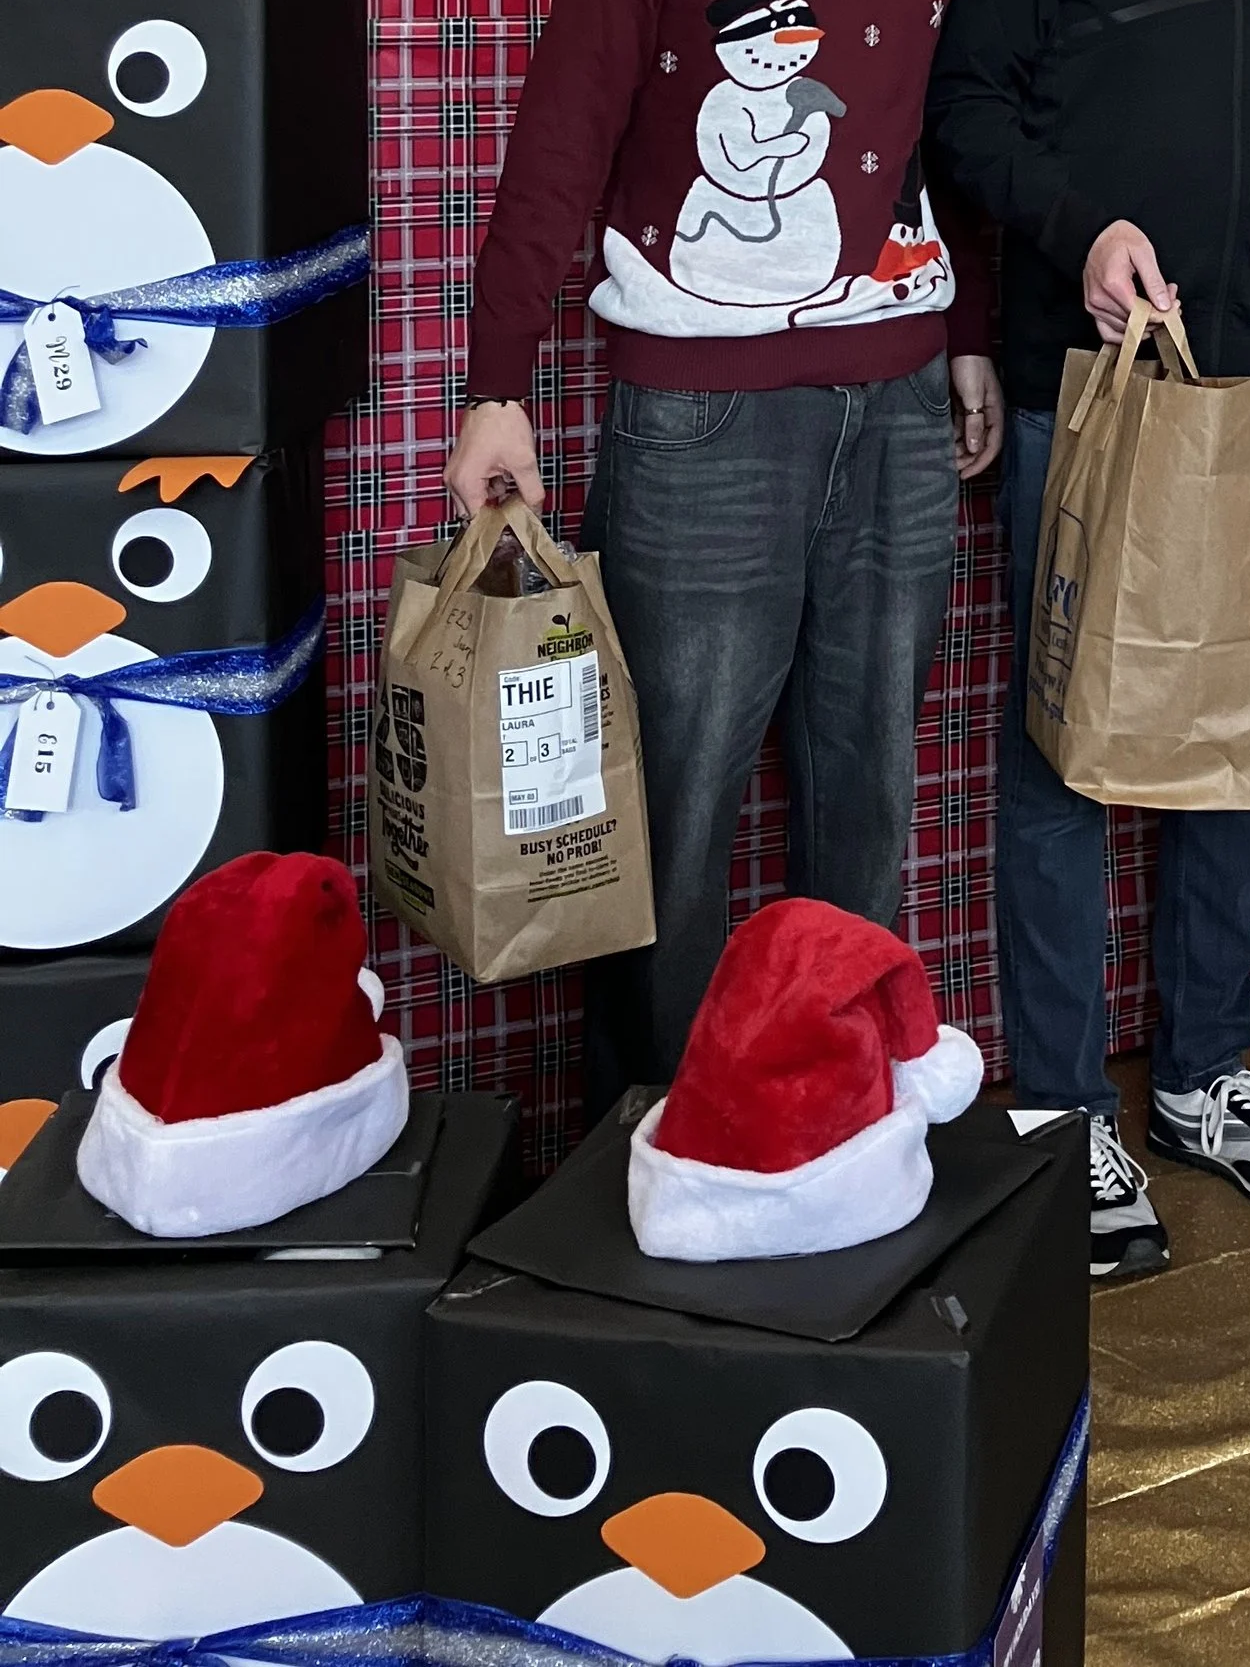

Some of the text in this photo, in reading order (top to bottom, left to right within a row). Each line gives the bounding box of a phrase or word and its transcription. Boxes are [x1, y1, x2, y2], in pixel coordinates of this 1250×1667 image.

[537, 632, 595, 659] NEIGHBOR
[502, 676, 555, 707] THIE
[502, 719, 536, 732] LAURA
[505, 748, 516, 763] 2
[540, 743, 550, 758] 3
[520, 838, 553, 856] BUSY
[555, 818, 618, 850] SCHEDULE?
[546, 850, 565, 866] NO
[566, 838, 603, 861] PROB!
